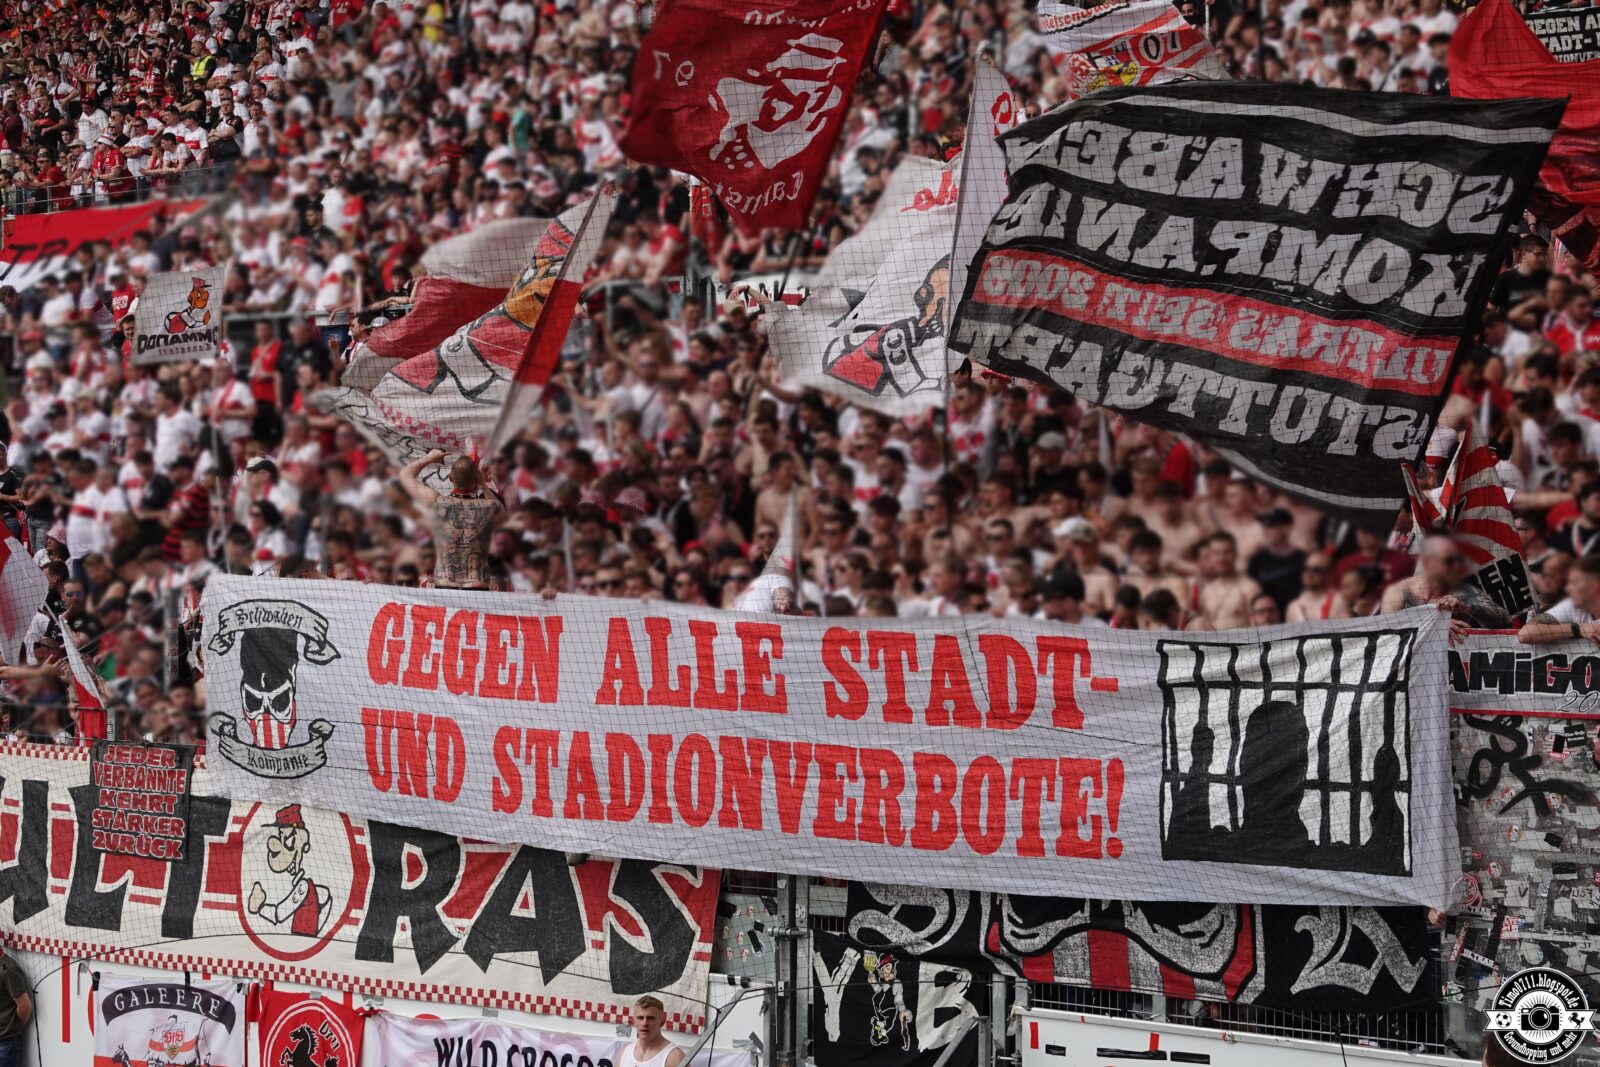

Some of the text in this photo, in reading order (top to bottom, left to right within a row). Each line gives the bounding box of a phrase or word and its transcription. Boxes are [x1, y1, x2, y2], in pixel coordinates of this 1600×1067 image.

[1540, 33, 1592, 52] TADT-
[235, 606, 303, 630] Schwaben
[367, 601, 1120, 731] GEGEN ALLE STADT-
[103, 744, 176, 768] JEDER
[247, 752, 309, 774] Kompanie
[93, 761, 187, 794] VERBANNTE
[361, 706, 1126, 861] UND STADIONVERBOTE!
[99, 788, 178, 814] KEHRT
[93, 829, 183, 859] ZURÜCK
[114, 987, 220, 1018] GALEERE
